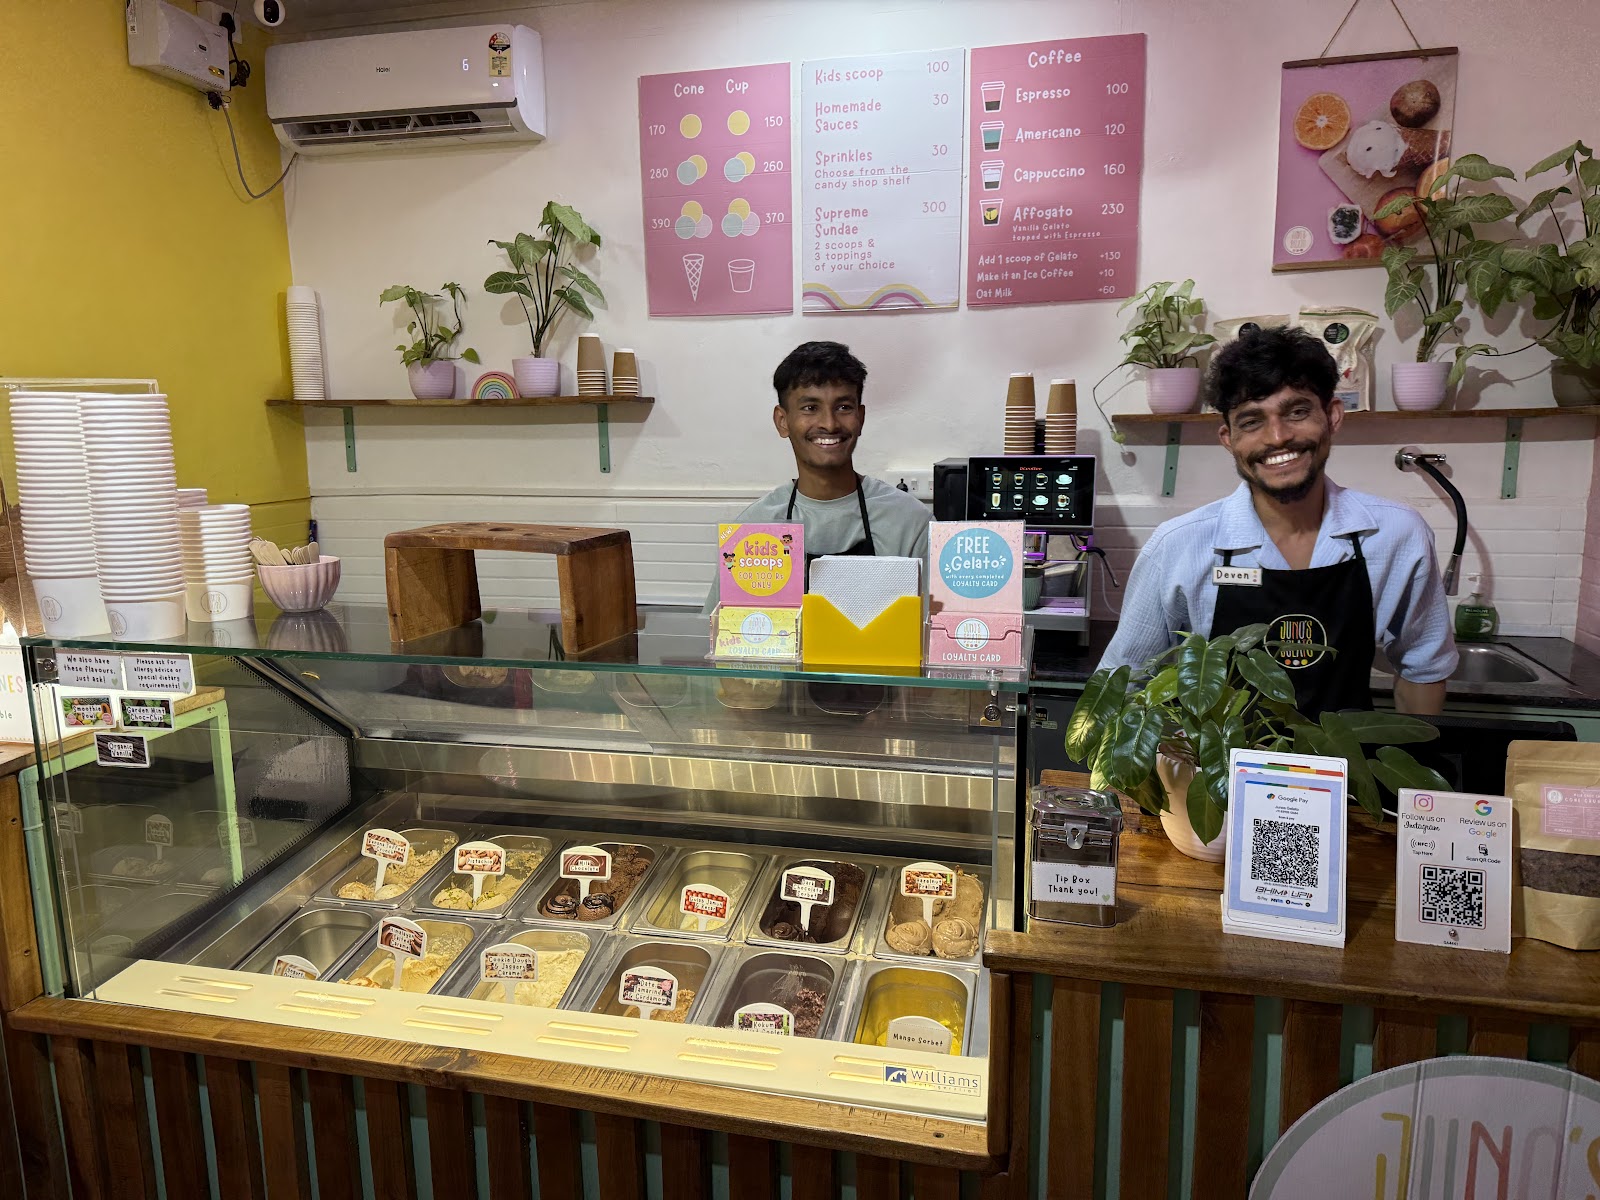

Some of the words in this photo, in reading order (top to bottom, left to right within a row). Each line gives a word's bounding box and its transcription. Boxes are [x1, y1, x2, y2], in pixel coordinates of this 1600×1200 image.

[1028, 50, 1082, 68] Coffee
[927, 61, 949, 74] 100
[815, 70, 841, 85] Kids
[845, 69, 883, 86] scoop
[674, 82, 704, 97] Cone
[725, 79, 749, 94] Cup
[1106, 82, 1128, 94] 100
[932, 94, 949, 106] 30
[1016, 87, 1071, 103] Espresso
[815, 99, 882, 117] Homemade
[764, 115, 783, 127] 150
[815, 119, 858, 133] Sauces
[648, 124, 666, 136] 170
[1015, 126, 1081, 142] Americano
[1105, 124, 1125, 135] 120
[932, 145, 948, 156] 30
[815, 149, 873, 166] Sprinkles
[763, 161, 784, 172] 260
[815, 169, 854, 179] Choose
[859, 167, 886, 176] from
[891, 165, 909, 174] the
[1103, 164, 1125, 175] 160
[650, 169, 669, 179] 280
[1014, 166, 1086, 183] Cappuccino
[815, 180, 847, 190] candy
[852, 178, 878, 188] shop
[882, 176, 910, 185] shelf
[922, 201, 946, 213] 300
[1101, 203, 1124, 215] 230
[765, 212, 784, 223] 370
[815, 207, 868, 223] Supreme
[1013, 205, 1073, 222] Affogato
[651, 219, 671, 229] 390
[1012, 224, 1040, 232] Vanilla
[1043, 222, 1070, 231] Gelato
[815, 223, 858, 238] Sundae
[1065, 230, 1101, 239] Espresso
[815, 242, 820, 250] 2
[825, 239, 862, 250] scoops
[868, 239, 875, 248] &
[815, 252, 820, 261] 3
[825, 250, 872, 261] toppings
[978, 255, 996, 266] Add
[998, 254, 1003, 265] 1
[1005, 255, 1032, 264] scoop
[1034, 253, 1045, 261] of
[1047, 251, 1078, 262] Gelato
[1100, 252, 1121, 260] +130
[814, 262, 826, 272] of
[830, 263, 854, 273] your
[858, 260, 895, 270] choice
[977, 271, 999, 282] Make
[1001, 271, 1009, 281] it
[1011, 272, 1021, 280] an
[1023, 270, 1038, 281] Ice
[1040, 268, 1074, 279] Coffee
[1099, 269, 1114, 277] +10
[976, 288, 992, 299] Oat
[994, 287, 1013, 298] Milk
[1098, 285, 1116, 294] +60
[720, 525, 733, 541] NEW!
[744, 541, 778, 556] kids
[956, 537, 990, 554] FREE
[739, 557, 783, 570] scoops
[951, 556, 999, 571] Gelato
[738, 572, 753, 580] FOR
[756, 572, 773, 580] 100
[775, 572, 784, 580] Rs
[1216, 570, 1249, 579] Deven
[751, 581, 772, 589] ONLY
[1280, 620, 1312, 640] JUNO'S
[719, 635, 741, 647] kids
[728, 647, 759, 655] LOYALTY
[66, 655, 78, 663] We
[80, 656, 93, 664] also
[942, 653, 977, 662] LOYALTY
[980, 653, 1001, 662] CARD
[92, 675, 106, 683] ask!
[126, 706, 149, 714] Garden
[108, 743, 133, 751] Organic
[1278, 795, 1298, 803] Google
[1401, 813, 1425, 821] Follow
[1460, 818, 1486, 826] Review
[1404, 822, 1440, 834] Instagram
[1469, 828, 1497, 838] Google
[1056, 874, 1068, 884] Tip
[1072, 875, 1090, 884] Box
[794, 884, 822, 893] Chocolate
[1049, 885, 1073, 893] Thank
[1078, 888, 1098, 896] you!
[1255, 886, 1283, 895] BHIM
[634, 987, 662, 995] Tamarind
[635, 994, 666, 1002] Cardamom
[893, 1033, 915, 1042] Mango
[918, 1037, 943, 1047] Sorbet
[910, 1069, 978, 1088] Williams
